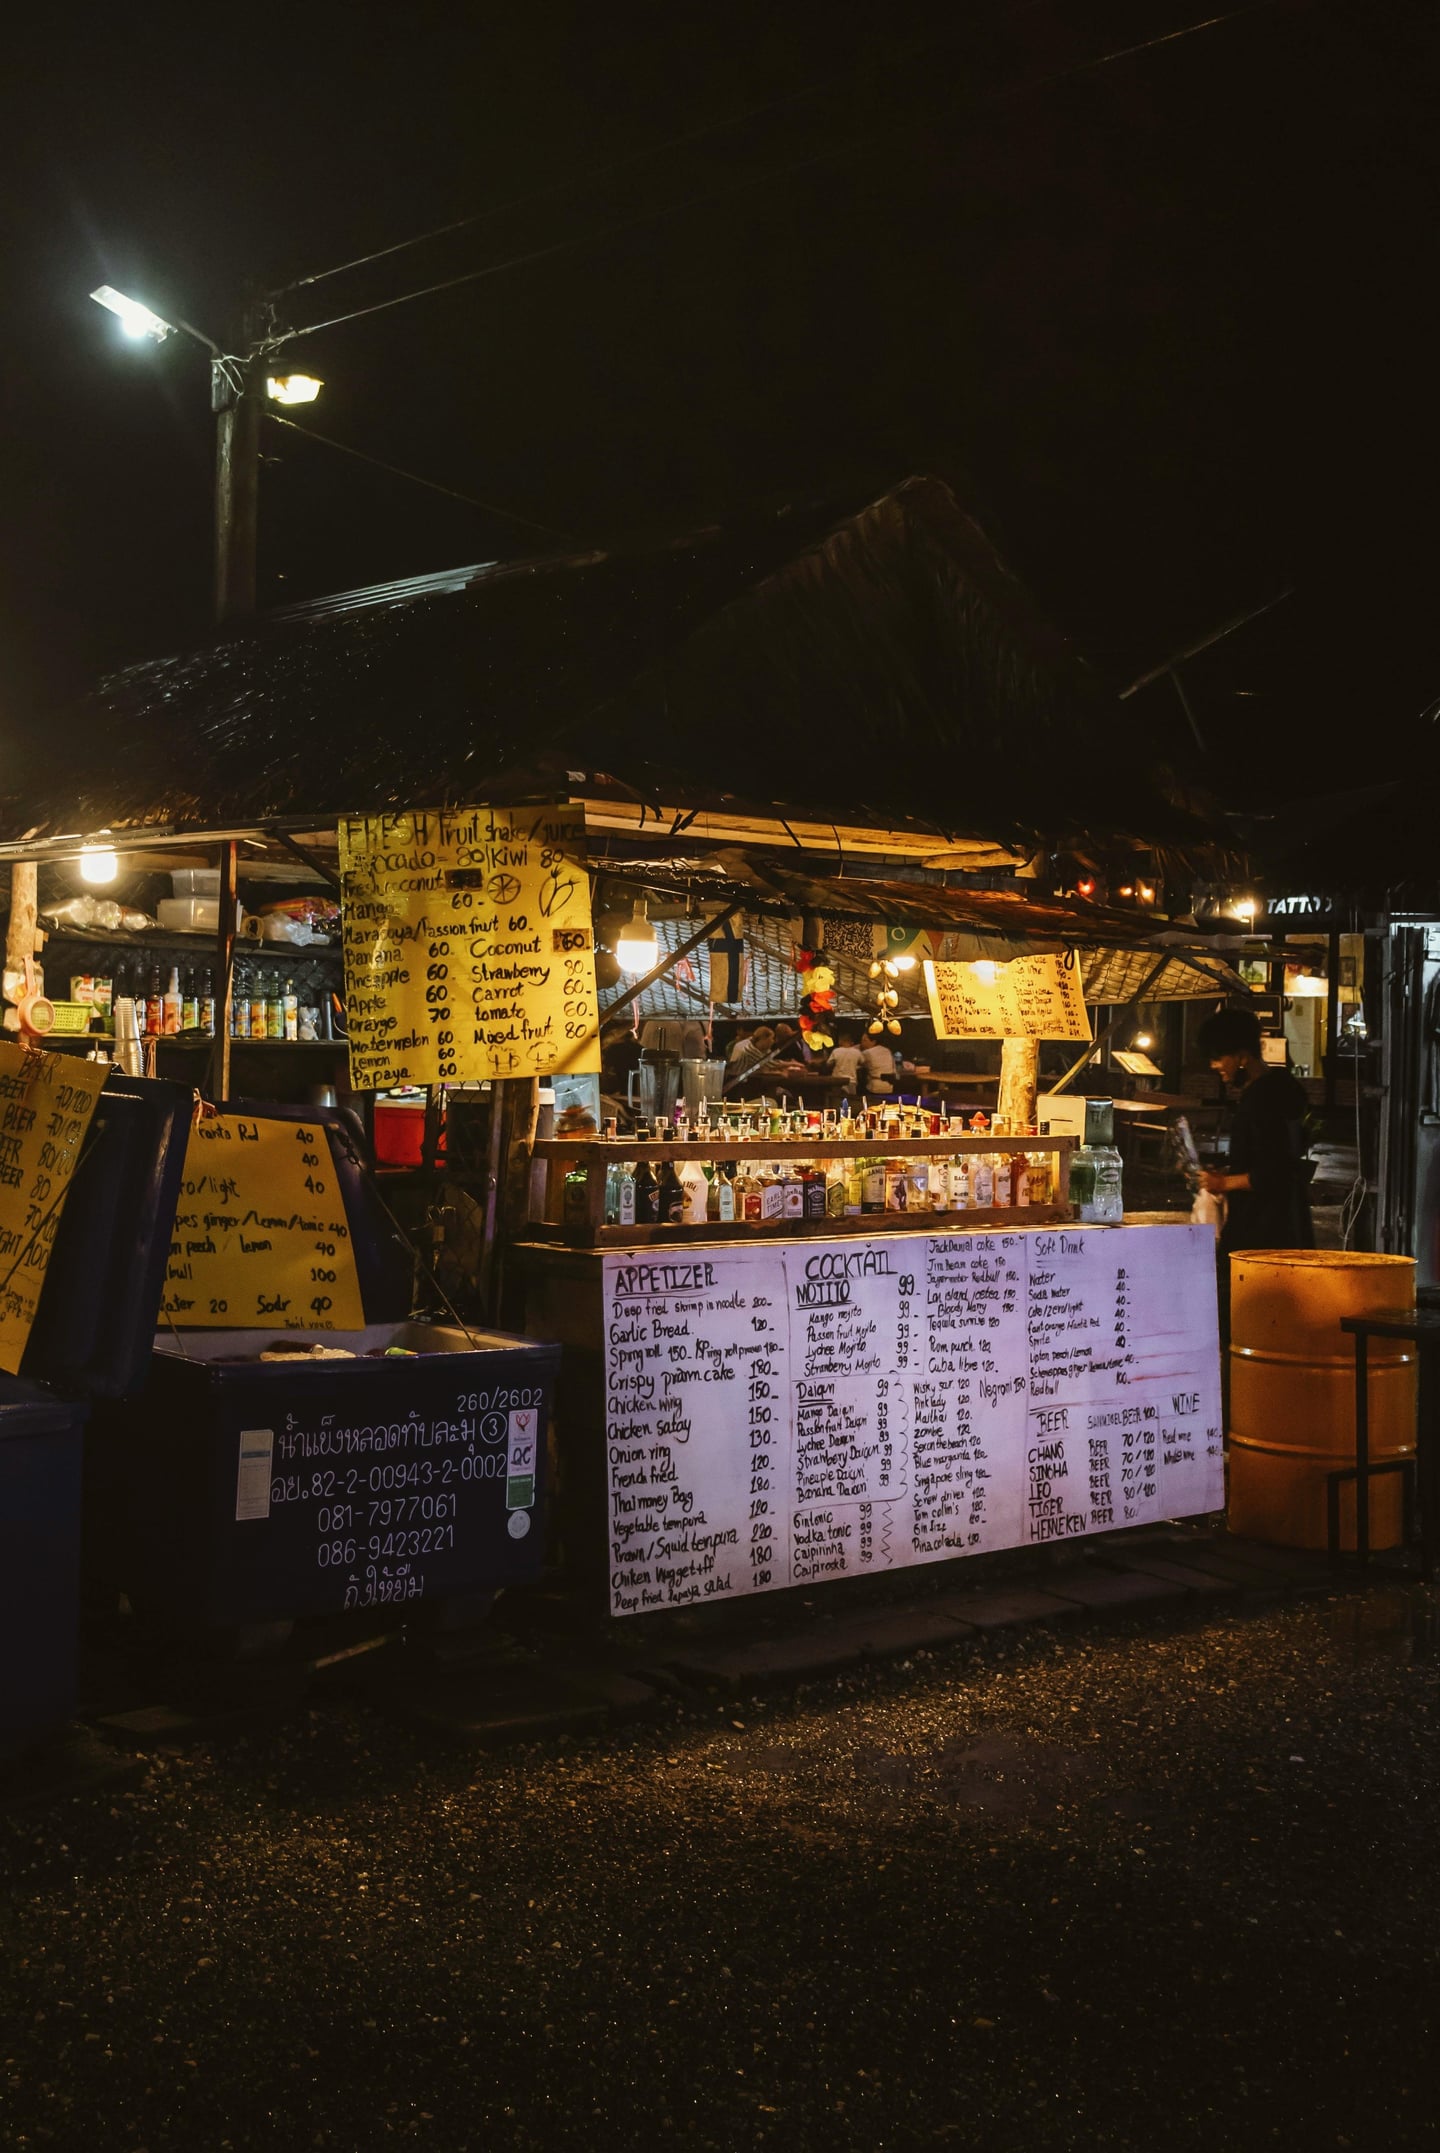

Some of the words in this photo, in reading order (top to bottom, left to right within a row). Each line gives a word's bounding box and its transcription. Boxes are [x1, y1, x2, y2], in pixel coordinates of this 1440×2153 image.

[456, 850, 485, 868] 80
[491, 845, 528, 867] Kiwi
[540, 849, 564, 868] 80
[470, 936, 542, 958] Coconut
[471, 964, 550, 987] Strawberry
[472, 984, 525, 1004] Carrot
[428, 1008, 450, 1022] 70
[474, 1002, 526, 1021] tomato
[350, 1029, 430, 1052] Watermelon
[473, 1026, 520, 1046] Mixed
[522, 1016, 553, 1041] fruit
[352, 1050, 390, 1070] Lemon
[352, 1065, 411, 1090] Papaya
[296, 1128, 314, 1144] 40
[302, 1152, 319, 1167] 40
[30, 1174, 51, 1201] 80
[304, 1174, 325, 1194] 40
[328, 1223, 348, 1238] 40
[315, 1241, 336, 1256] 40
[310, 1268, 337, 1283] 100
[805, 1250, 898, 1280] COCKTAIL
[1029, 1272, 1056, 1287] Water
[796, 1279, 851, 1304] MOJITO
[209, 1299, 228, 1313] 20
[310, 1296, 333, 1316] 40
[613, 1301, 642, 1322] Deep
[645, 1297, 668, 1317] fried
[706, 1300, 714, 1310] in
[715, 1289, 746, 1309] noodle
[609, 1319, 648, 1346] Garlic
[928, 1357, 955, 1373] Cuba
[958, 1355, 978, 1370] libre
[608, 1371, 655, 1400] Crispy
[704, 1364, 736, 1382] cake
[958, 1378, 970, 1390] 120
[979, 1377, 1012, 1408] Negroni
[456, 1386, 544, 1413] 260/2602
[607, 1396, 657, 1415] Chicken
[659, 1396, 683, 1418] wing
[1171, 1392, 1201, 1416] WINE
[608, 1422, 652, 1441] Chicken
[1036, 1408, 1070, 1434] BEER
[609, 1444, 646, 1465] Onion
[648, 1444, 671, 1473] ring
[1088, 1457, 1111, 1472] BEER
[1089, 1473, 1111, 1489] BEER
[611, 1490, 636, 1517] Thai
[670, 1485, 694, 1513] Bag
[1029, 1496, 1064, 1518] TIGER
[1090, 1490, 1113, 1506] BEER
[317, 1493, 457, 1533] 081-7977061
[1091, 1507, 1115, 1526] BEER
[613, 1512, 660, 1544] Vegetable
[793, 1528, 824, 1545] Vodka
[317, 1524, 455, 1568] 086-9423221
[614, 1590, 640, 1612] Deep
